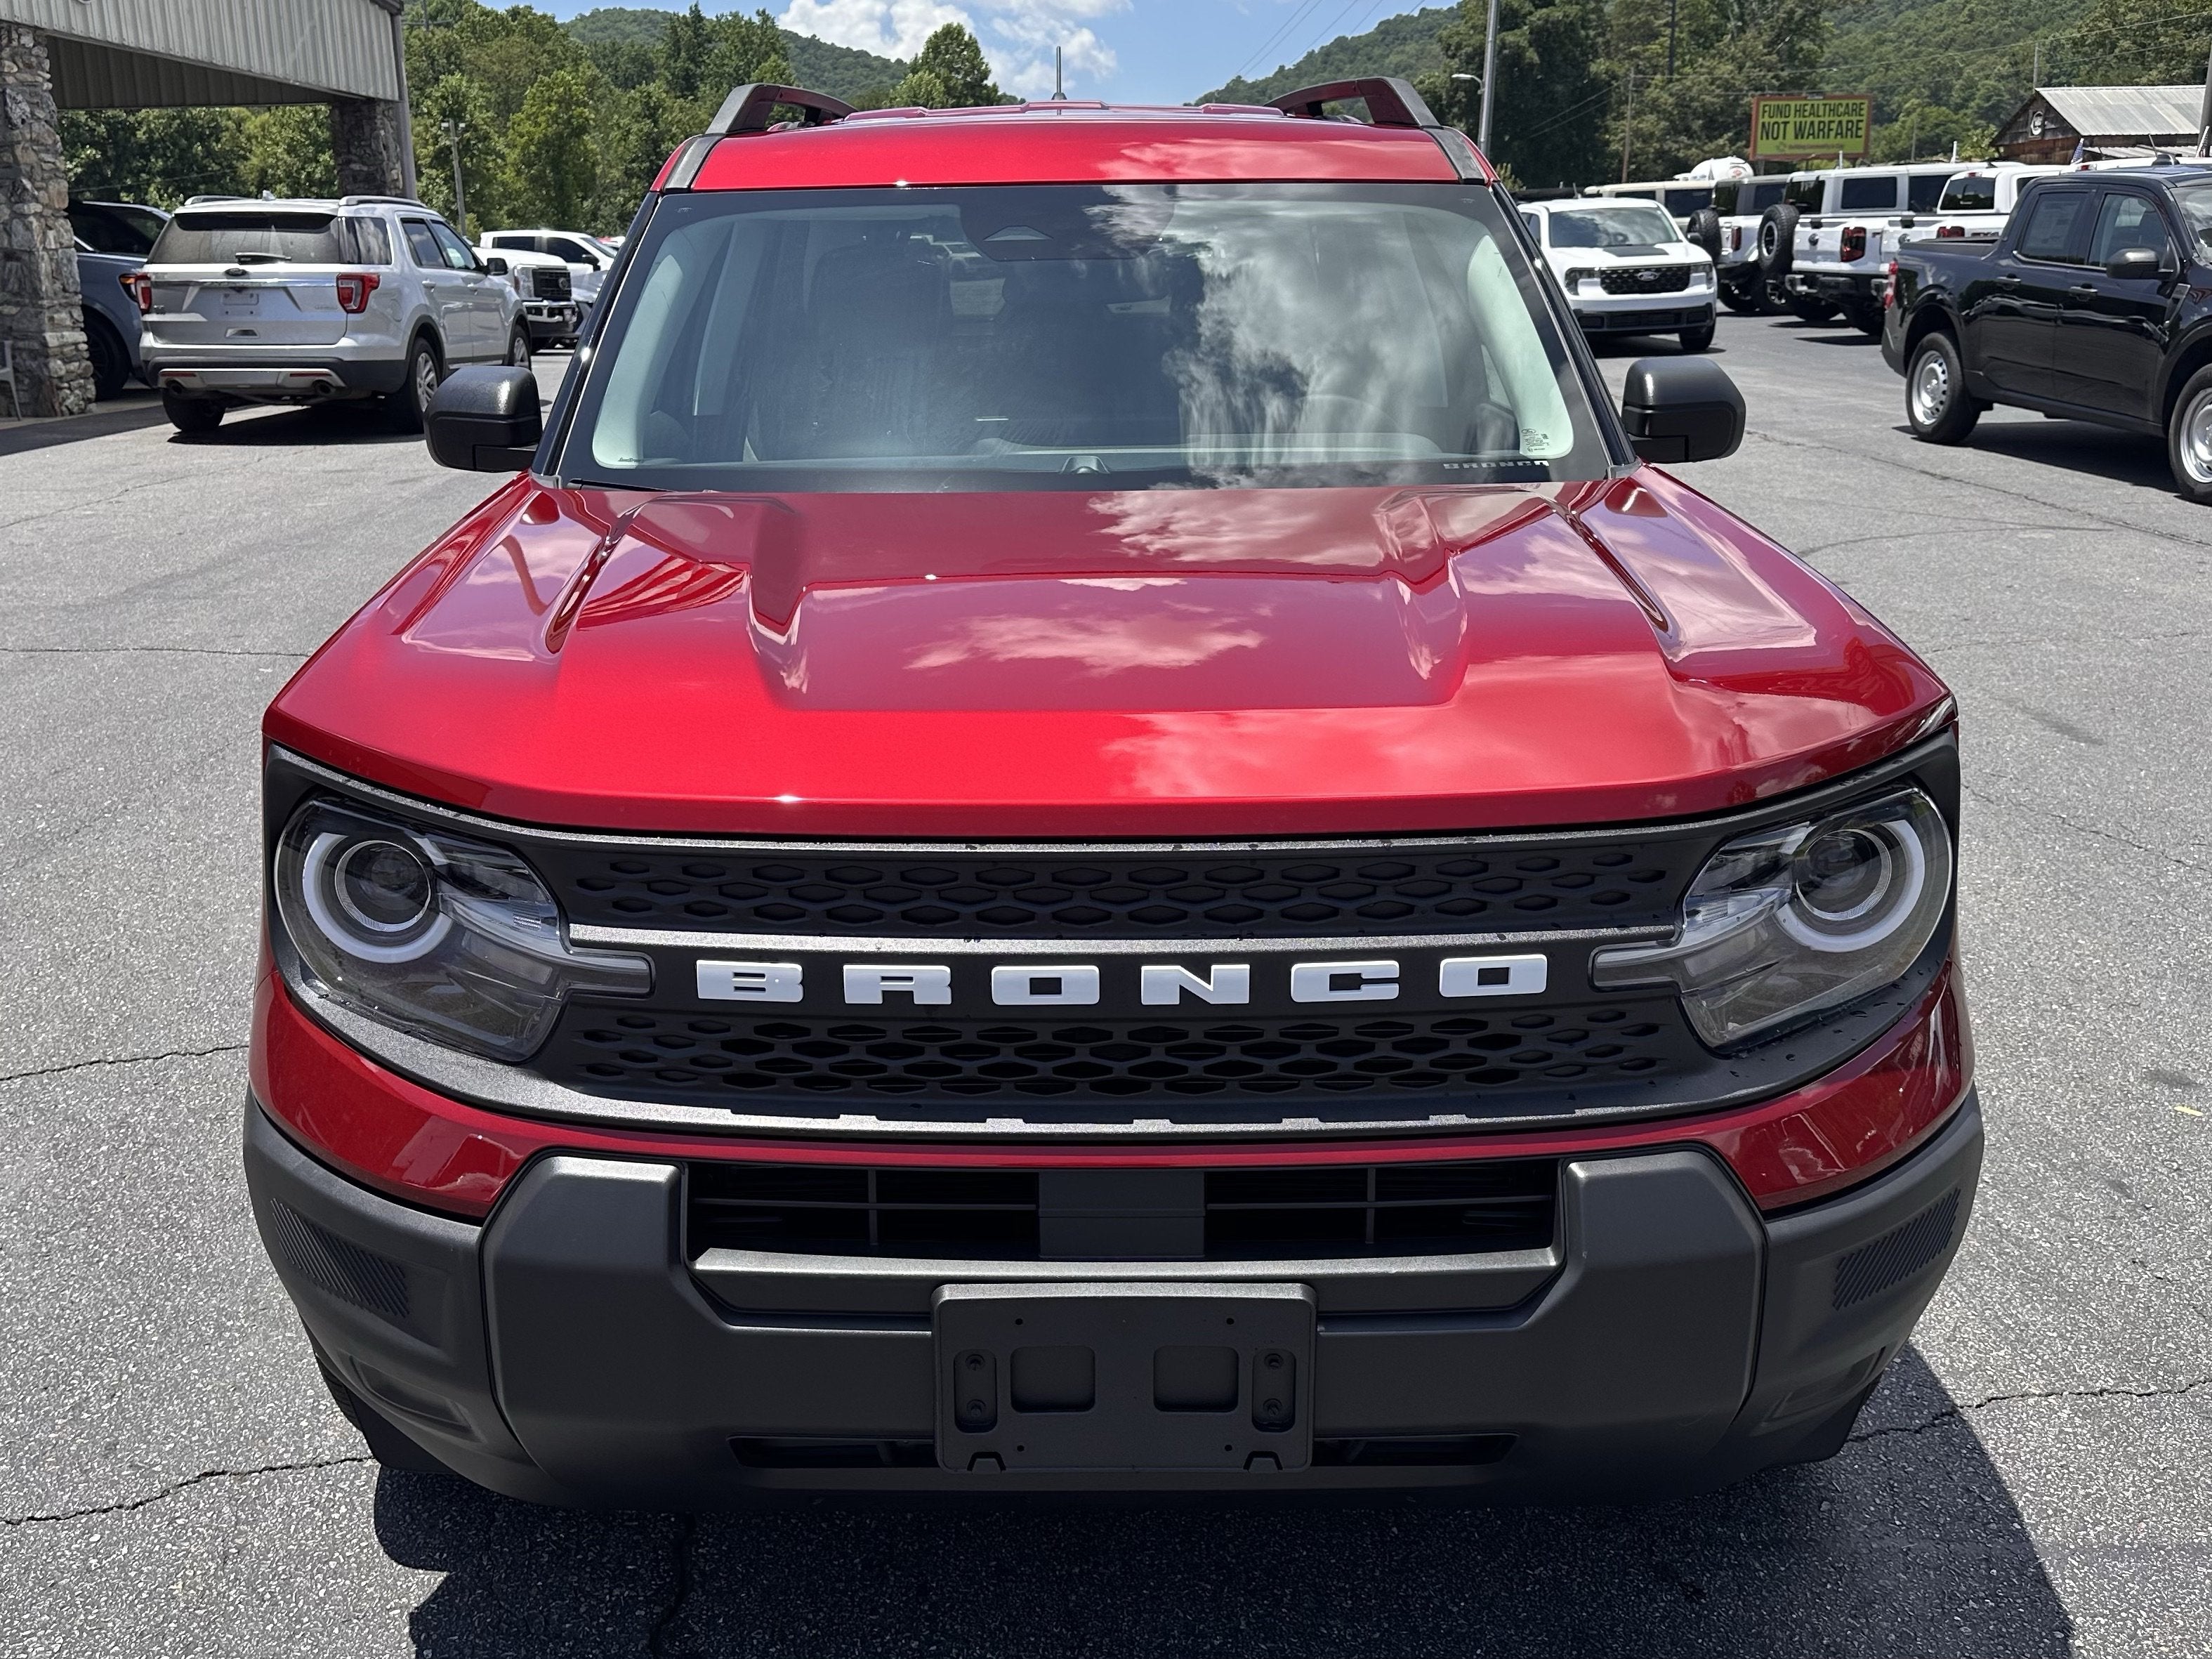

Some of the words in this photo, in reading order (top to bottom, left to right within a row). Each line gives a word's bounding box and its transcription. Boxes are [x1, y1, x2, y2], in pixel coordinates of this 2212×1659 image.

[1761, 103, 1791, 119] FUND
[1793, 102, 1865, 118] HEALTHCARE
[1760, 121, 1790, 140] NOT
[1793, 119, 1864, 140] WARFARE
[696, 954, 1548, 1005] BRONCO
